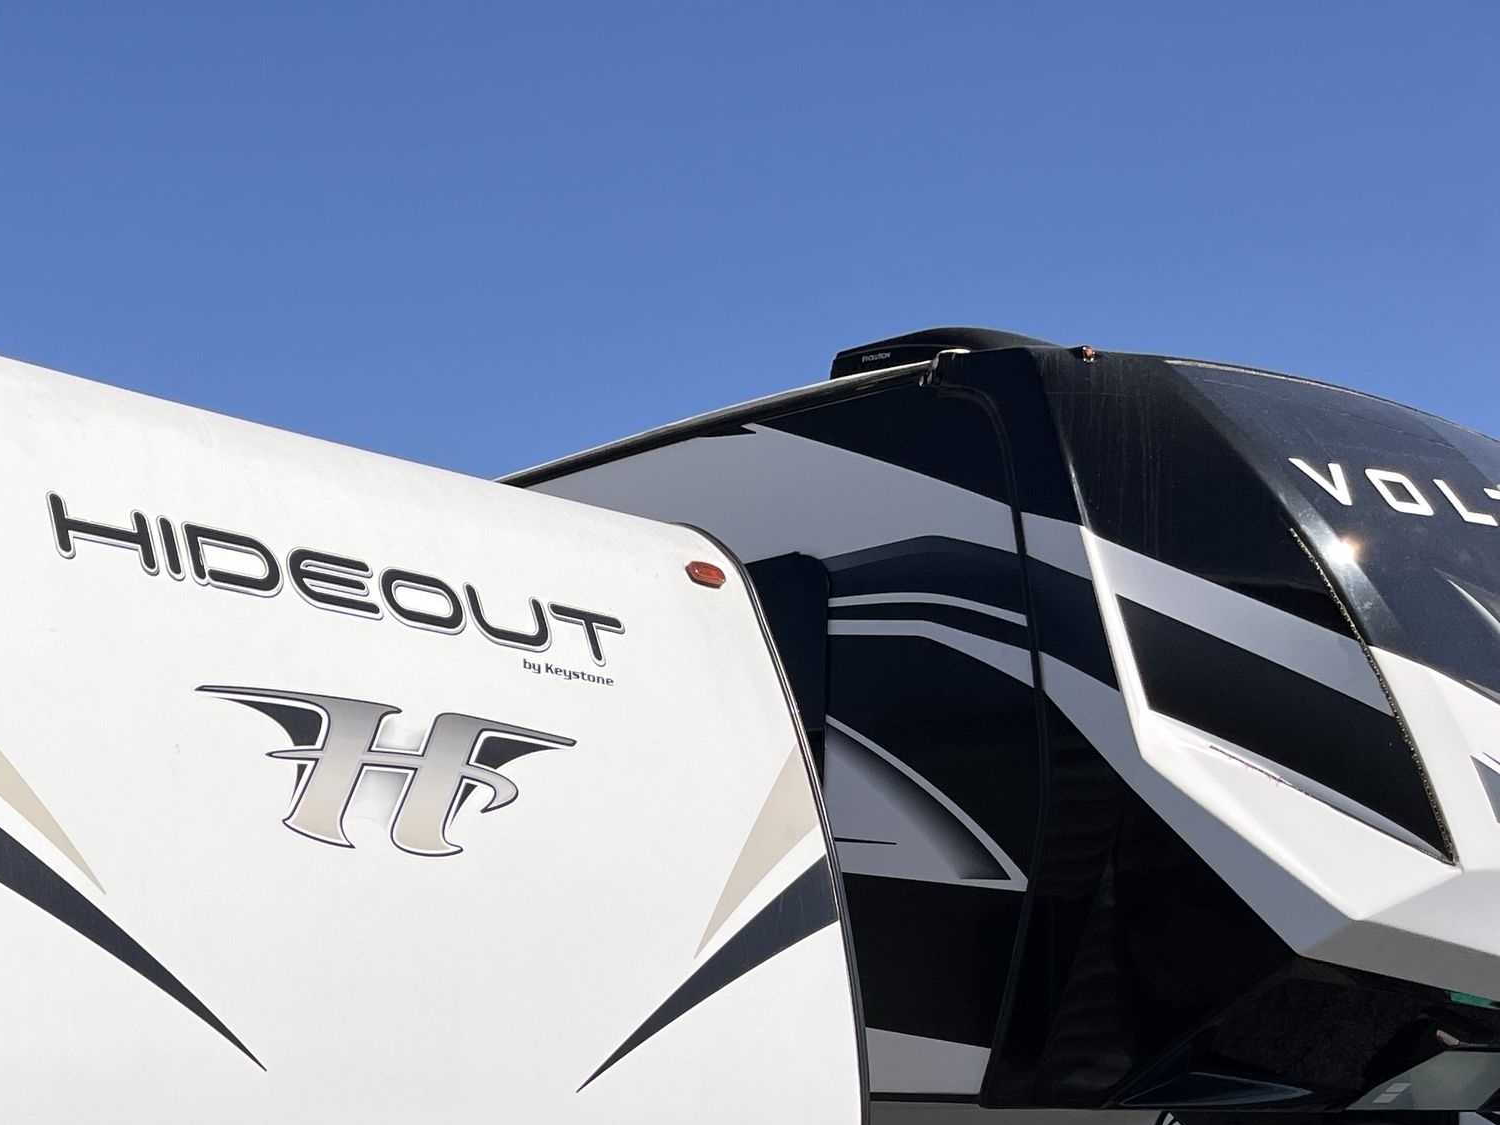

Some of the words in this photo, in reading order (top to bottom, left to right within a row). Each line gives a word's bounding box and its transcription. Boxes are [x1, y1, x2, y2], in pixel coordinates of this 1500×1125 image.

[1288, 457, 1500, 527] VOL
[46, 491, 625, 666] HIDEOUT
[522, 658, 542, 675] by
[544, 662, 615, 687] Keystone
